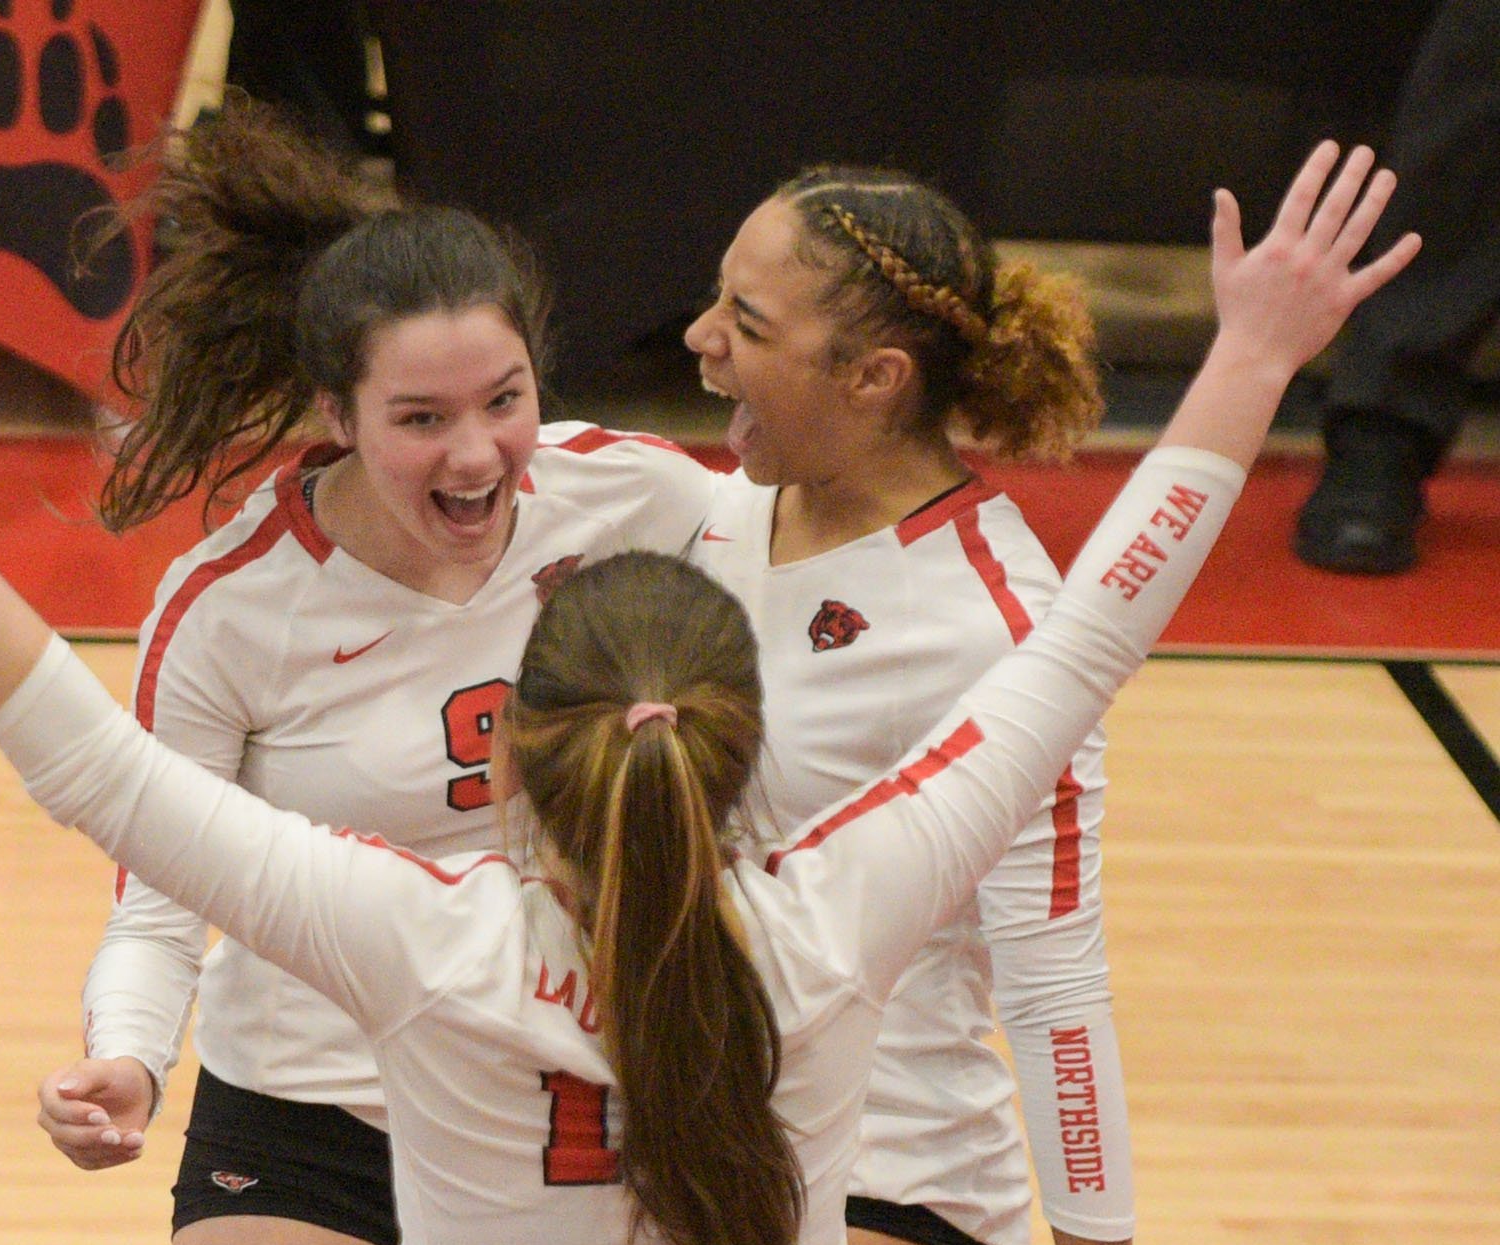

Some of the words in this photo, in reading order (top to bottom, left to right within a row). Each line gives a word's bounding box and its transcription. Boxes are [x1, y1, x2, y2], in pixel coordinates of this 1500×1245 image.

[1150, 482, 1209, 541] WE
[1100, 531, 1168, 602] ARE
[441, 677, 515, 812] 9
[1050, 1025, 1106, 1194] NORTHSIDE
